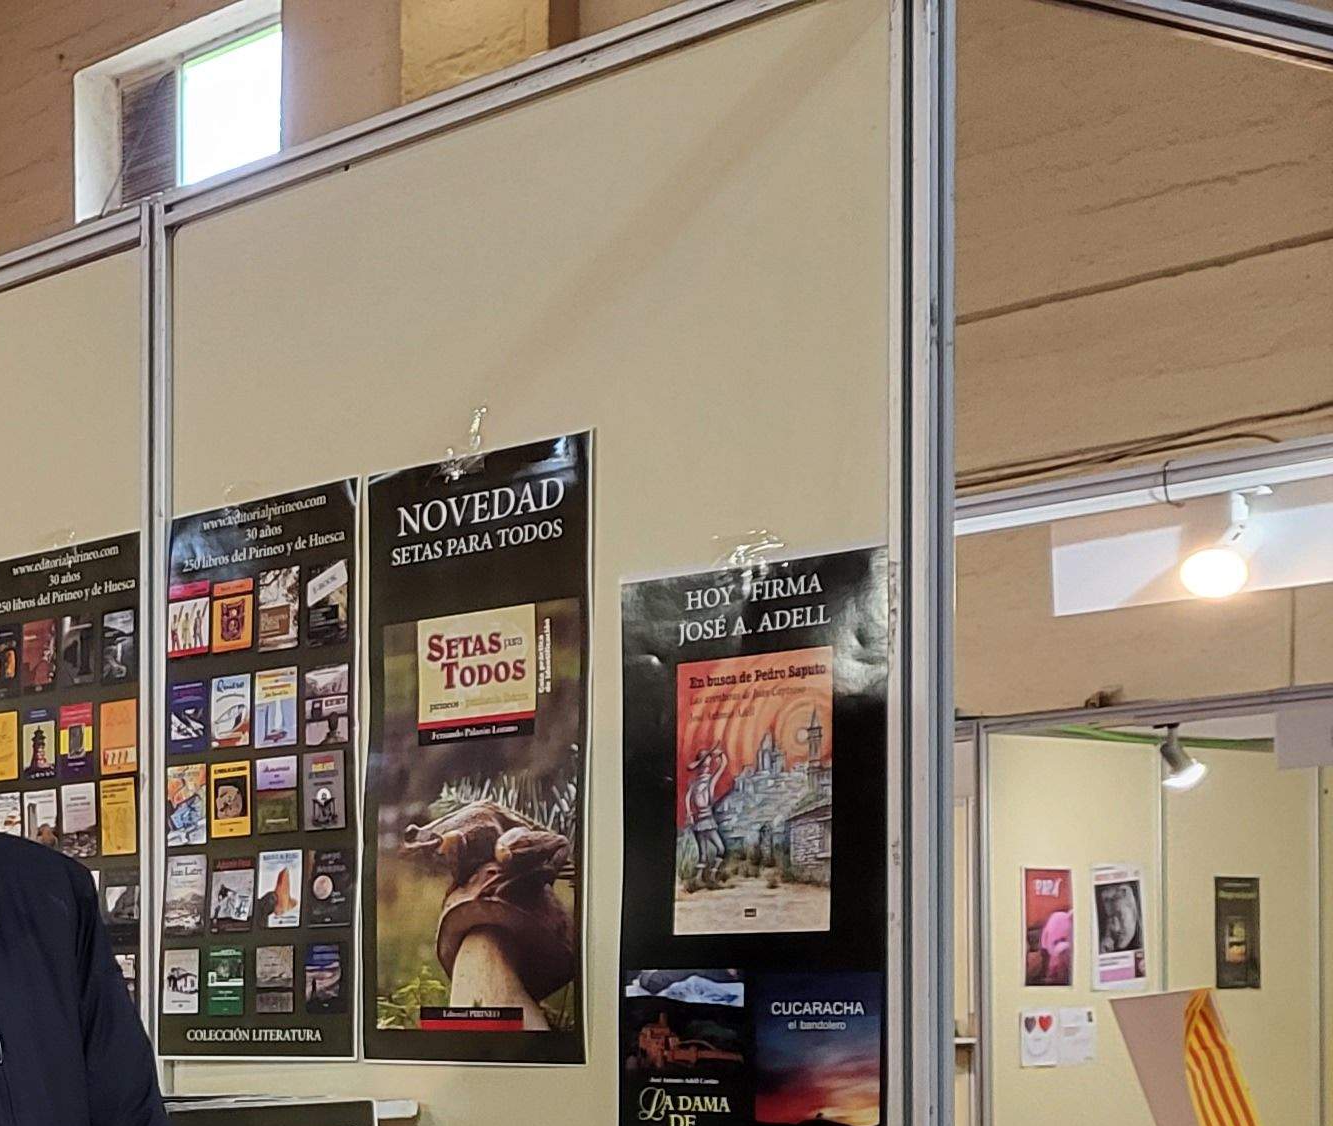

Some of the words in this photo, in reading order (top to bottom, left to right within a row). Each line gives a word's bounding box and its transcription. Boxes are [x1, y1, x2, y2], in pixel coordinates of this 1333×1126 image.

[397, 477, 565, 537] NOVEDAD
[391, 540, 443, 567] SETAS
[446, 531, 493, 557] PARA
[497, 518, 563, 548] TODOS
[685, 585, 735, 611] HOY
[750, 573, 823, 602] FIRMA
[678, 614, 727, 647] JOSÉ
[731, 616, 753, 636] A.
[756, 605, 832, 632] ADELL
[427, 632, 502, 662] SETAS
[503, 636, 523, 650] para
[440, 659, 526, 690] TODOS
[690, 677, 704, 689] En
[707, 674, 736, 688] busca
[739, 671, 752, 683] de
[754, 669, 785, 682] Pedro
[788, 664, 826, 680] Saputo
[770, 1001, 865, 1016] CUCARACHA
[186, 1027, 250, 1041] COLECCIÓN
[252, 1029, 322, 1041] LITERATURA
[638, 1086, 674, 1121] LA
[679, 1096, 731, 1113] DAMA
